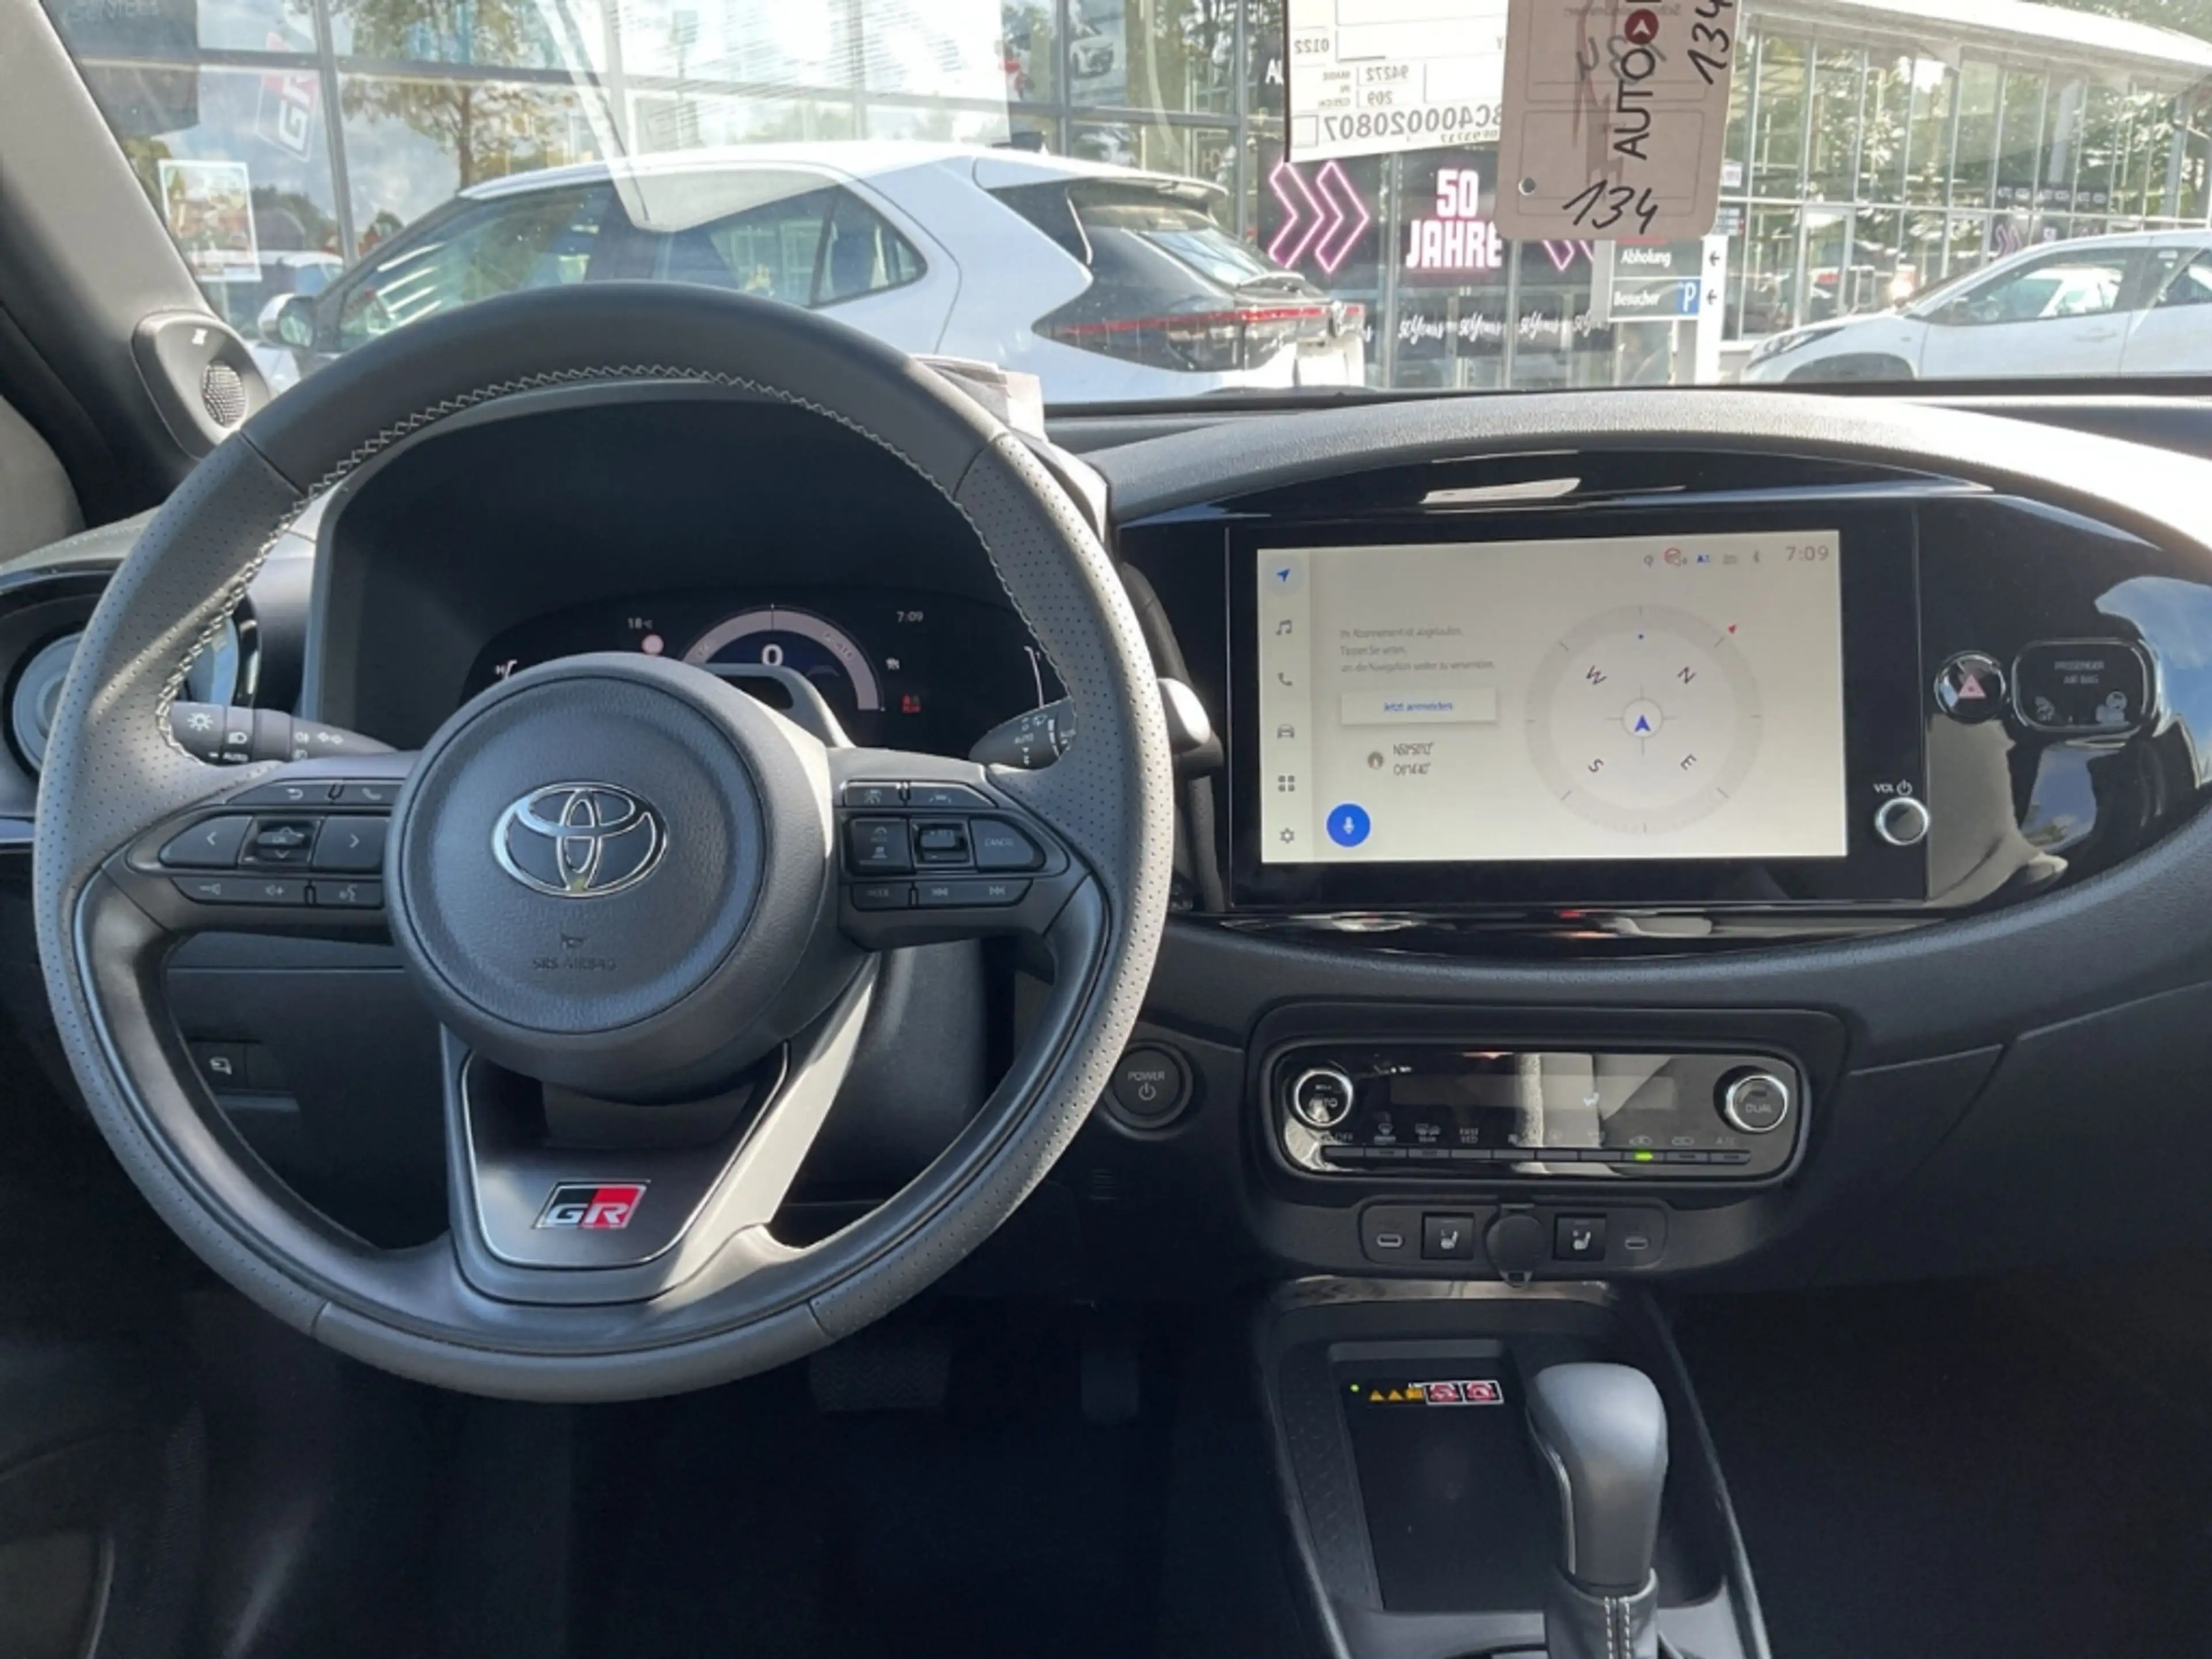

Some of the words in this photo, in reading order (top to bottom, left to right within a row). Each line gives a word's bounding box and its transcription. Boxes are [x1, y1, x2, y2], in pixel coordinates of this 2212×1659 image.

[1613, 48, 1656, 160] AUTO
[1436, 169, 1479, 218] 50
[1562, 179, 1658, 236] 134
[1406, 219, 1502, 269] JAHRE
[1620, 248, 1672, 268] Abholung
[1613, 290, 1661, 306] Besucher
[1785, 545, 1830, 561] 7:09
[896, 611, 924, 623] 7:09
[761, 643, 783, 666] 0
[1586, 665, 1608, 685] W
[1677, 666, 1696, 684] N
[1587, 757, 1604, 773] S
[1680, 753, 1697, 771] E
[1127, 1071, 1165, 1081] POWER
[546, 1203, 630, 1225] GR
